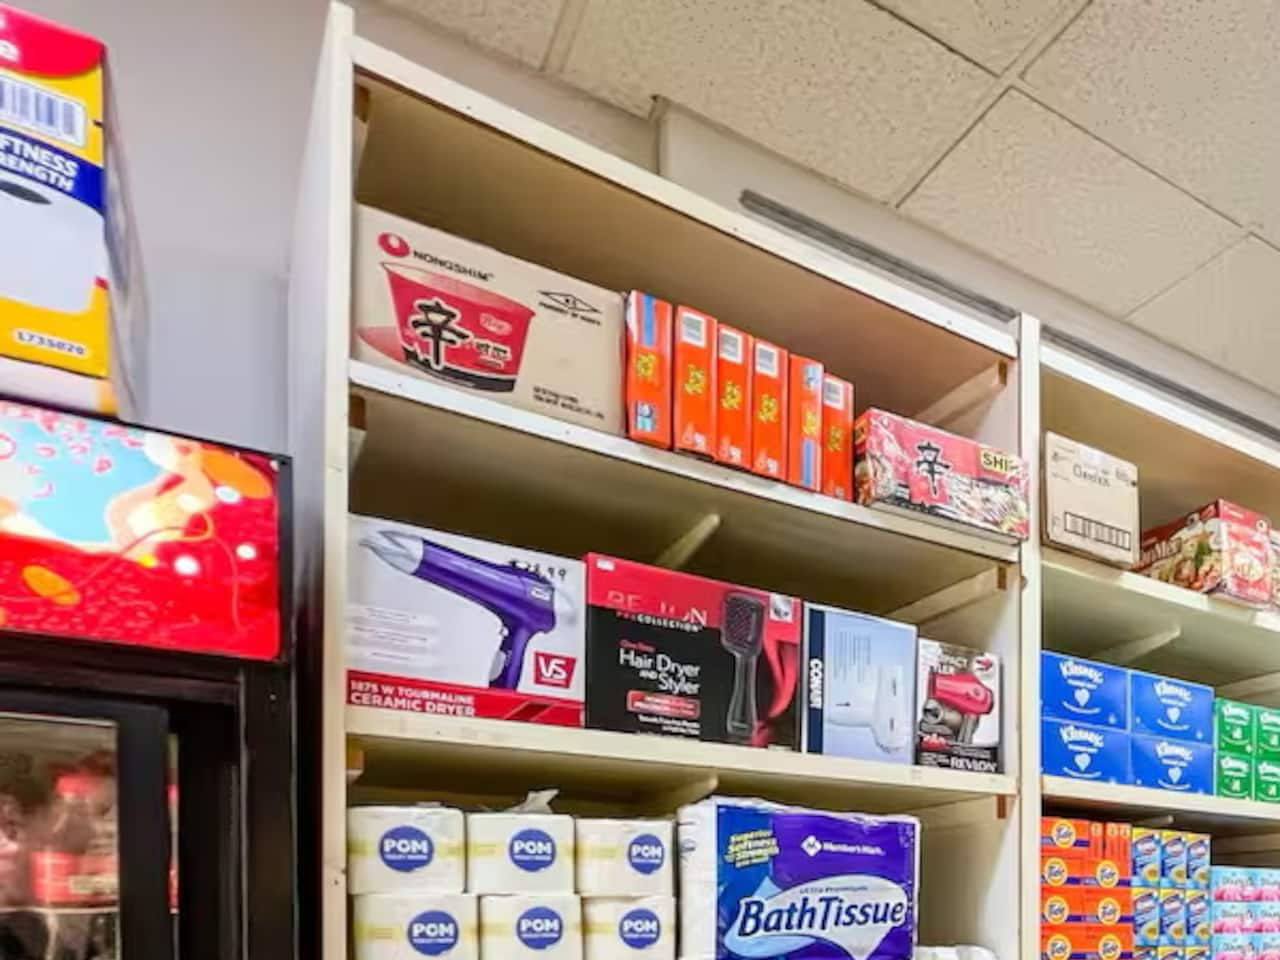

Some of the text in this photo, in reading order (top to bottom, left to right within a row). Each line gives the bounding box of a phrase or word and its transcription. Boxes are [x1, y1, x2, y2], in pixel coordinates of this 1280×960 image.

[413, 250, 490, 281] NONGSHIM
[411, 301, 469, 367] 辛
[538, 655, 568, 680] VS
[620, 648, 700, 678] Hair Dryer
[398, 687, 475, 706] TOURMALINE
[658, 675, 700, 694] Styler
[351, 692, 475, 718] CERAMIC DRYER
[951, 757, 998, 773] REVLON
[738, 896, 906, 938] Bath Tissue
